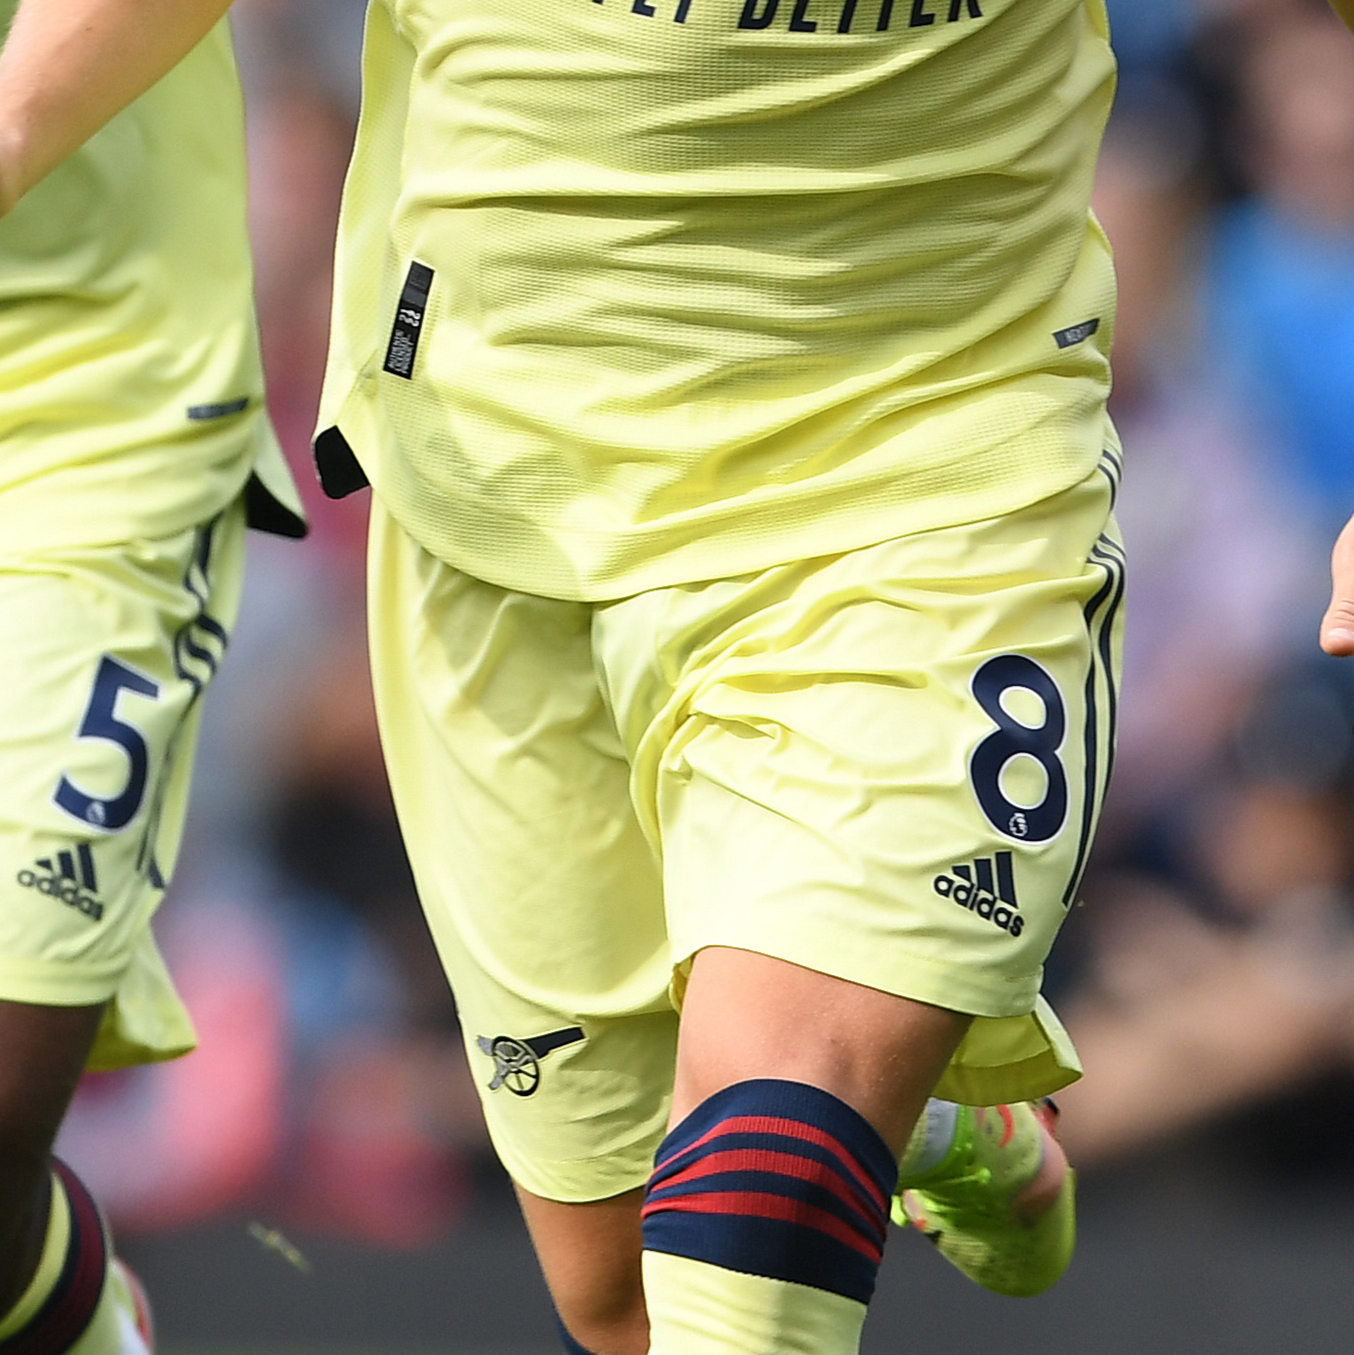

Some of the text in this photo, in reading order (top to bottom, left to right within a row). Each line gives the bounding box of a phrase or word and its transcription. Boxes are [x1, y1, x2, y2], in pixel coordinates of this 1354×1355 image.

[52, 651, 164, 836] 5
[968, 651, 1071, 846] 8
[16, 869, 104, 922] adidas
[932, 874, 1025, 938] adidas
